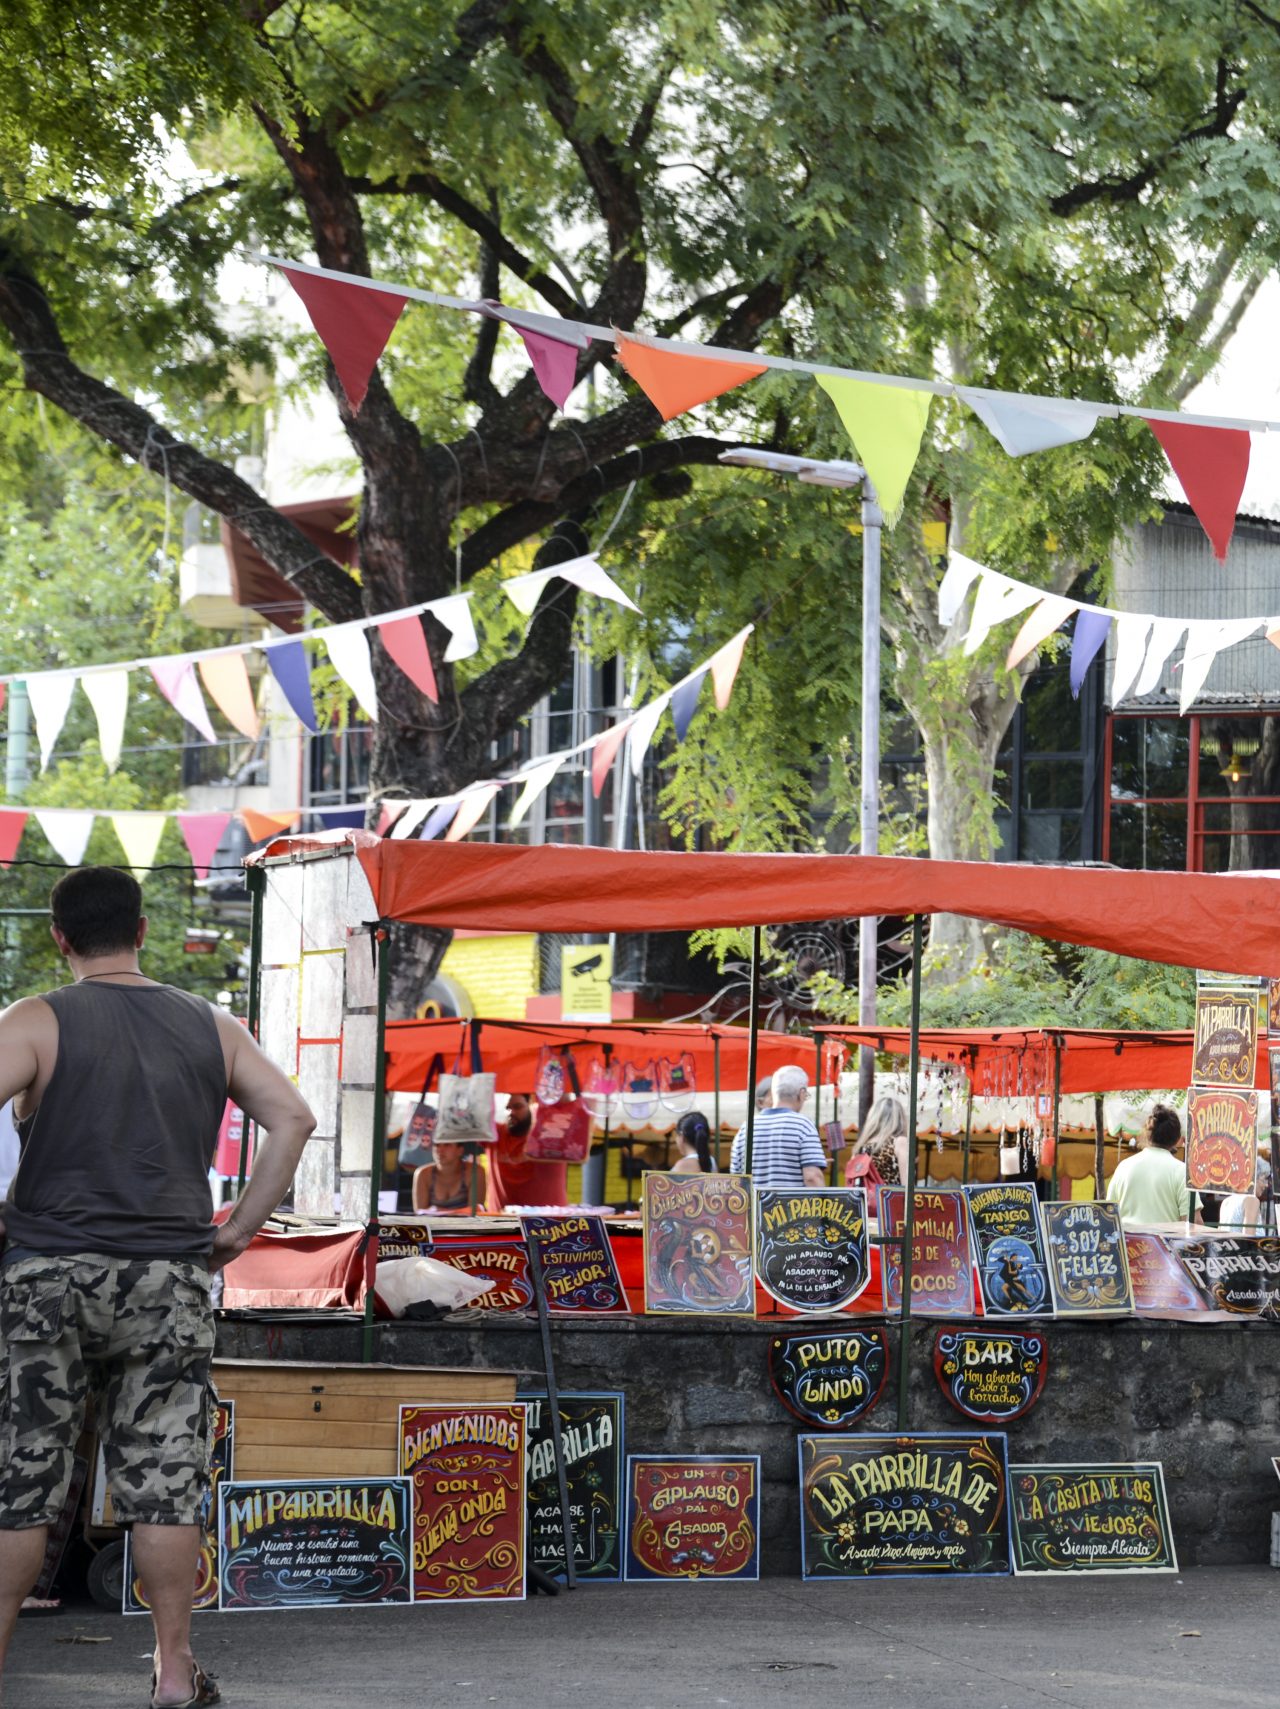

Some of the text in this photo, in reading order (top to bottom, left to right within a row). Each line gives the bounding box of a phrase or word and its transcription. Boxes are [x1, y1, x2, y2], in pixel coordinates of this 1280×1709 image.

[1209, 1003, 1253, 1044] PARRILLA
[1197, 1099, 1254, 1156] PARRILLA
[651, 1178, 749, 1219] BUENOS AIRES
[914, 1193, 945, 1211] STA
[970, 1187, 1033, 1213] BUENOS AIRES
[763, 1198, 863, 1238] MI PARRILLA
[981, 1209, 1030, 1223] TANGO
[895, 1218, 955, 1243] FMILIA
[1069, 1229, 1101, 1253] SOY
[800, 1250, 833, 1259] APLAUSO
[926, 1245, 939, 1261] DE
[1216, 1239, 1240, 1251] MI
[444, 1251, 525, 1273] IEMPRE
[543, 1249, 605, 1265] ESTUVIMOS
[822, 1269, 839, 1277] OTRO
[1058, 1254, 1118, 1284] FELIZ
[804, 1284, 813, 1292] LA
[798, 1339, 860, 1367] PUTO
[965, 1340, 1014, 1365] BAR
[804, 1376, 863, 1402] LINDO
[964, 1369, 1021, 1387] Hoy abierto
[1000, 1385, 1009, 1393] a
[969, 1388, 1022, 1404] borrachos
[404, 1414, 519, 1470] BIENVENIDOS
[684, 1470, 705, 1479] UN
[813, 1449, 998, 1519] LA PARRILLA DE
[652, 1484, 740, 1511] APLAUSO
[1018, 1477, 1153, 1521] LA CASITA DE LOS
[230, 1486, 396, 1549] MI PARRILLA
[569, 1505, 585, 1516] SE
[865, 1503, 934, 1534] PAPÁ
[413, 1487, 507, 1571] BUENA ONDA
[664, 1520, 728, 1549] ASADOR
[1068, 1512, 1137, 1535] VIEJOS
[258, 1539, 294, 1553] Nunca
[295, 1540, 306, 1550] se
[340, 1540, 360, 1549] una
[534, 1543, 585, 1558] MAGA
[902, 1542, 935, 1561] Amigos
[934, 1549, 942, 1560] y
[942, 1542, 967, 1559] más
[1059, 1537, 1150, 1564] Siempre Abierta
[263, 1552, 379, 1566] buena historia comiendo
[292, 1566, 358, 1578] una ensalada
